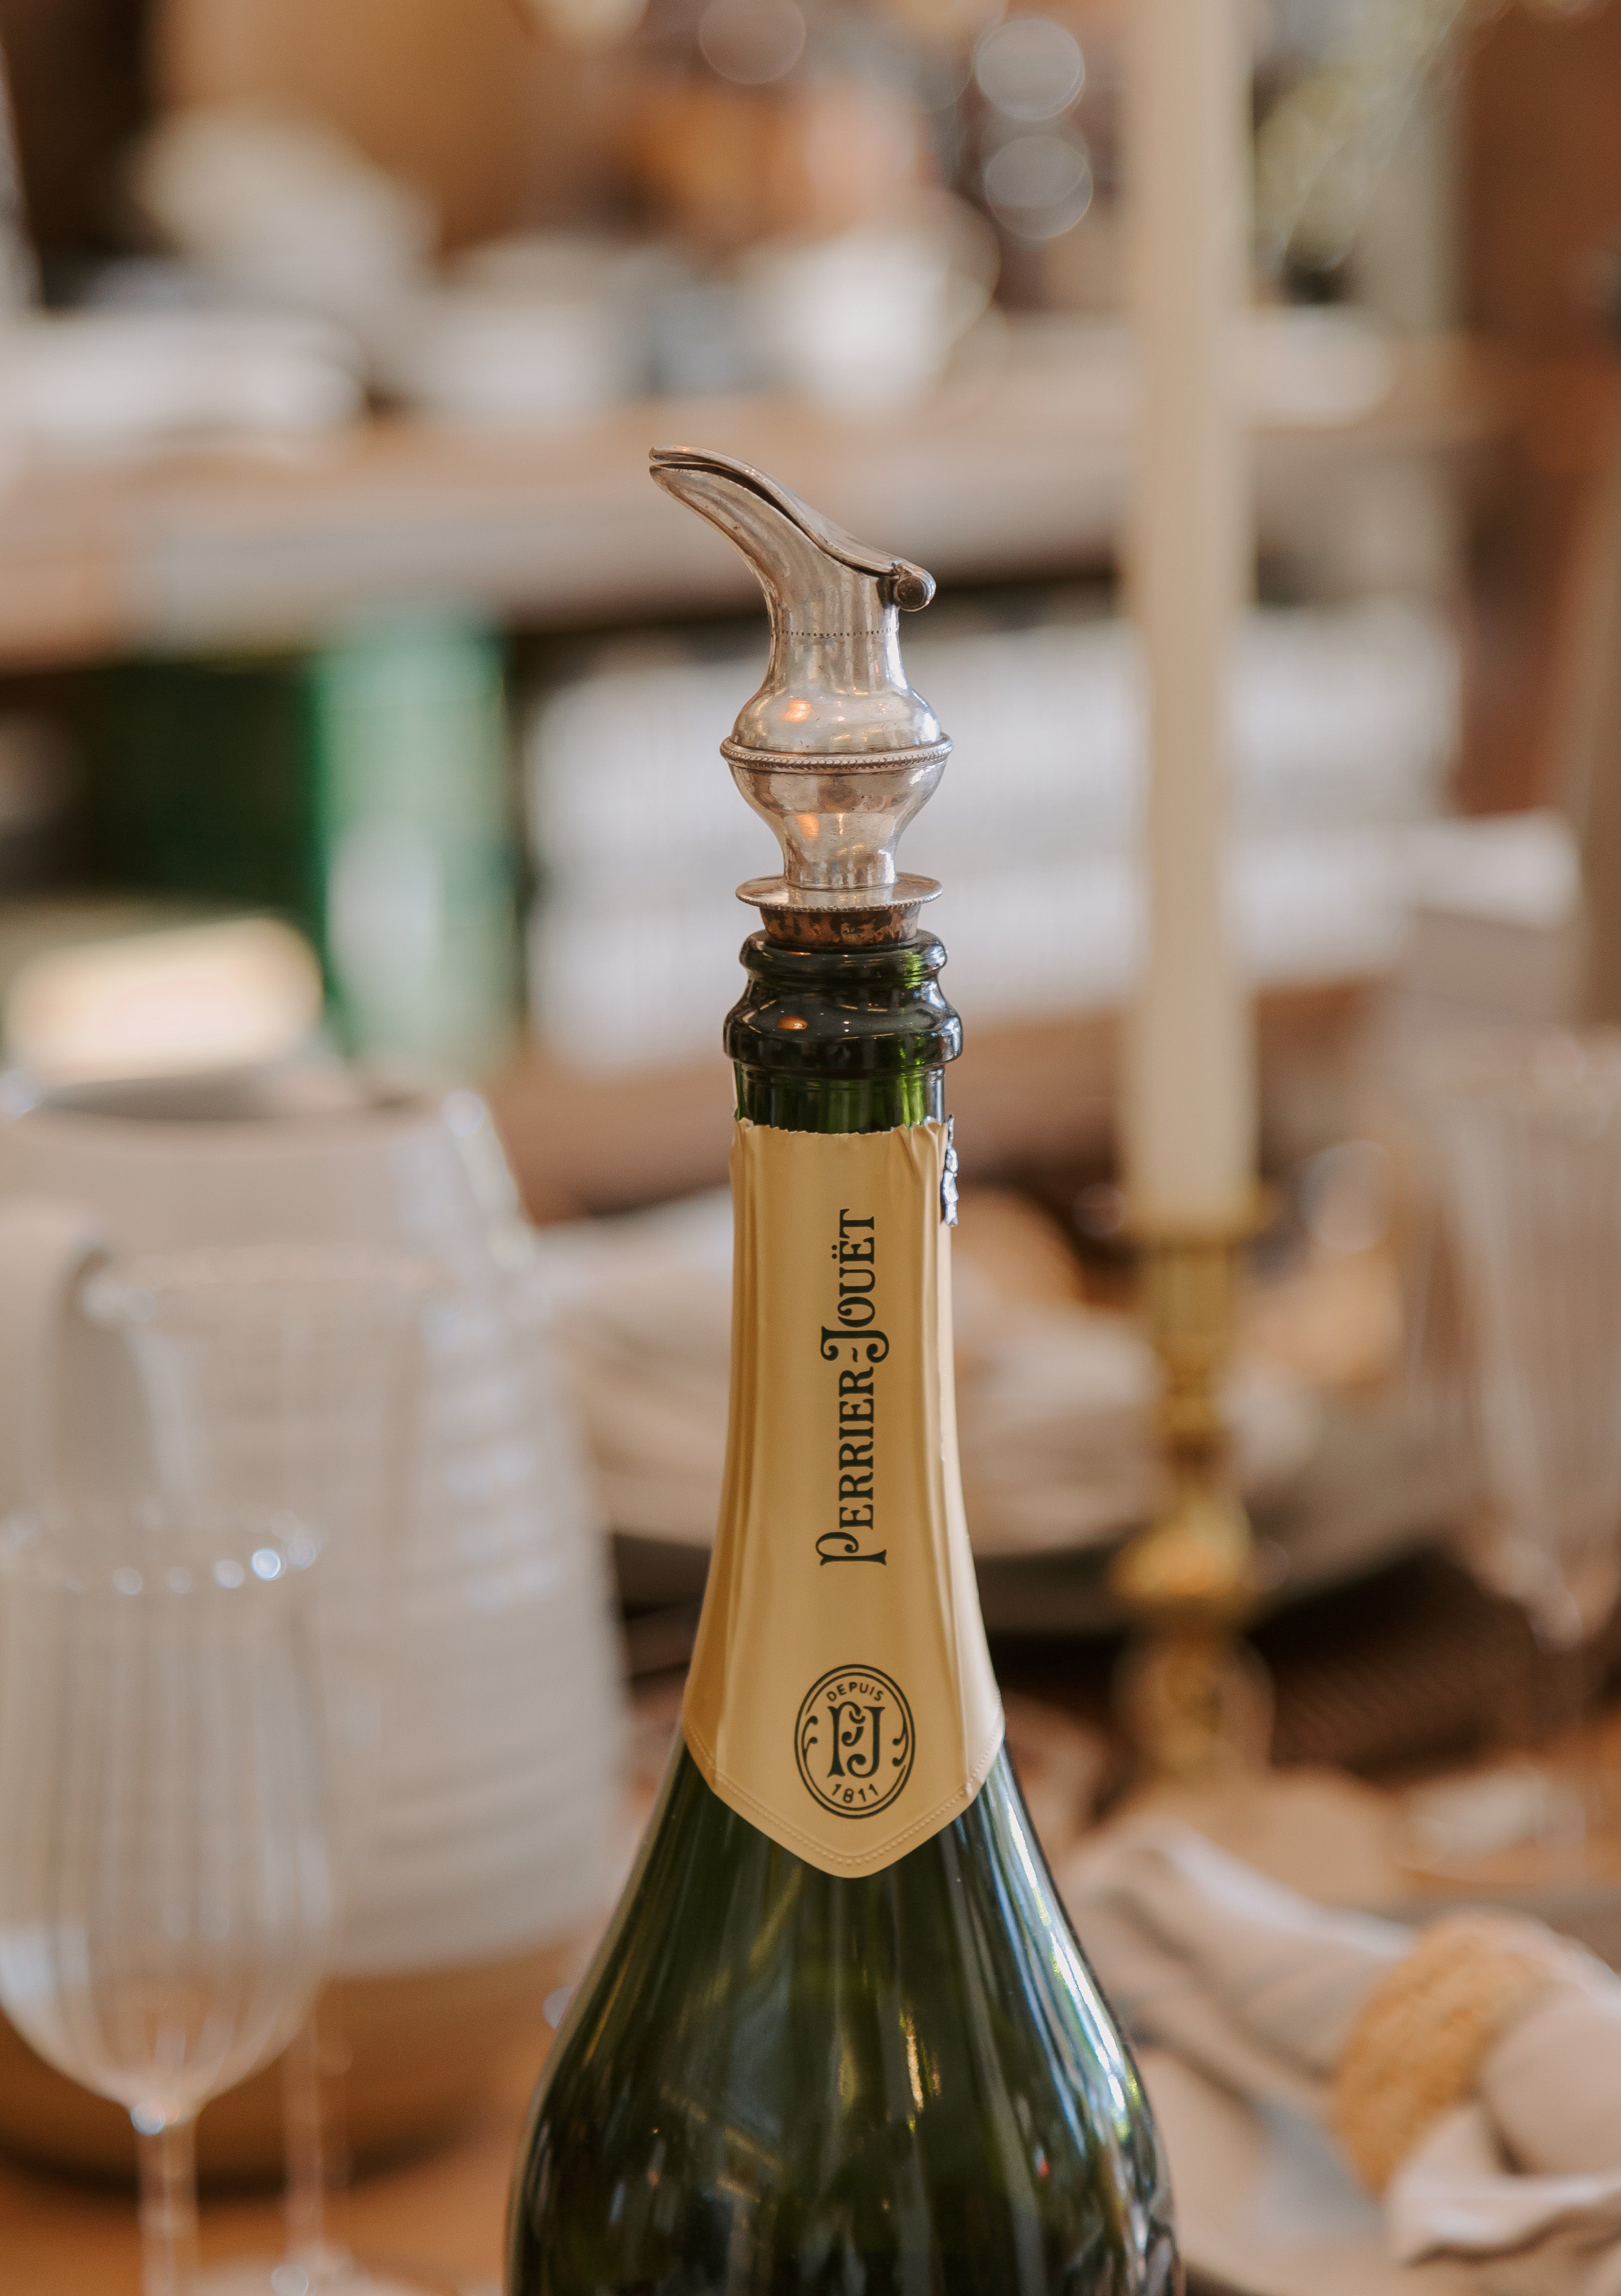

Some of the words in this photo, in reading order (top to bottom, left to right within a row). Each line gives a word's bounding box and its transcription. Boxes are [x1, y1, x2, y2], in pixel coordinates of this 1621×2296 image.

[816, 1208, 889, 1566] PERRIER-JOUËT
[827, 1681, 884, 1702] DEPUIS
[832, 1783, 879, 1804] 1811
